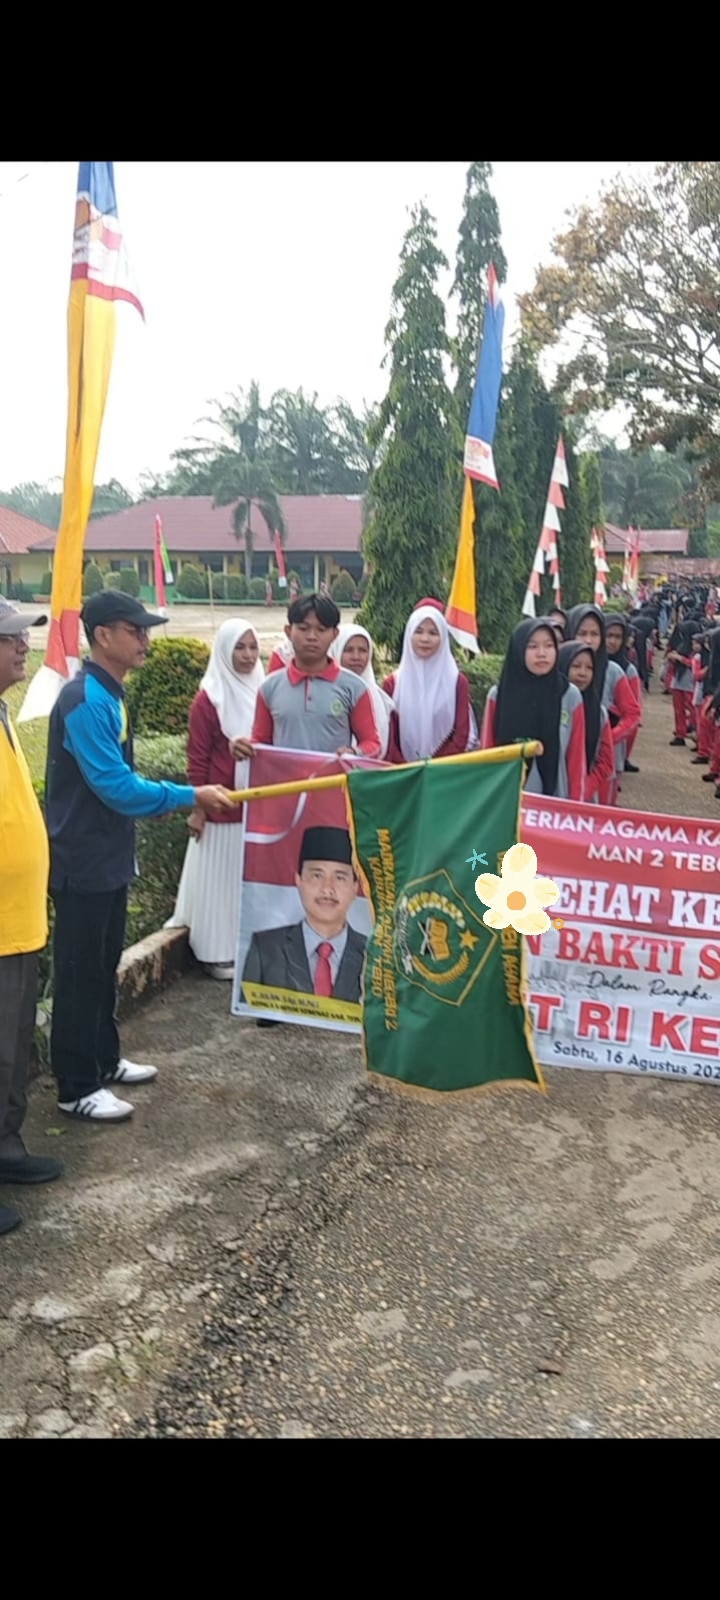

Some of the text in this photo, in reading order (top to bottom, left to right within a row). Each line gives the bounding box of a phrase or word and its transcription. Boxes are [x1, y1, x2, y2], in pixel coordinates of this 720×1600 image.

[599, 819, 690, 845] AGAMA
[587, 843, 643, 867] MAN
[649, 848, 665, 868] 2
[536, 874, 660, 924] EHAT
[668, 889, 720, 935] KE
[377, 829, 398, 1031] MADRASAH ALIYAH NEGERI 2
[554, 927, 686, 977] BAKTI
[698, 944, 720, 981] S
[372, 955, 384, 997] TEBO
[587, 970, 713, 1007] Dalam Rangka
[522, 993, 720, 1058] T RI KE
[553, 1041, 599, 1063] Sabtu,
[606, 1048, 624, 1065] 16
[627, 1053, 688, 1075] Agustus
